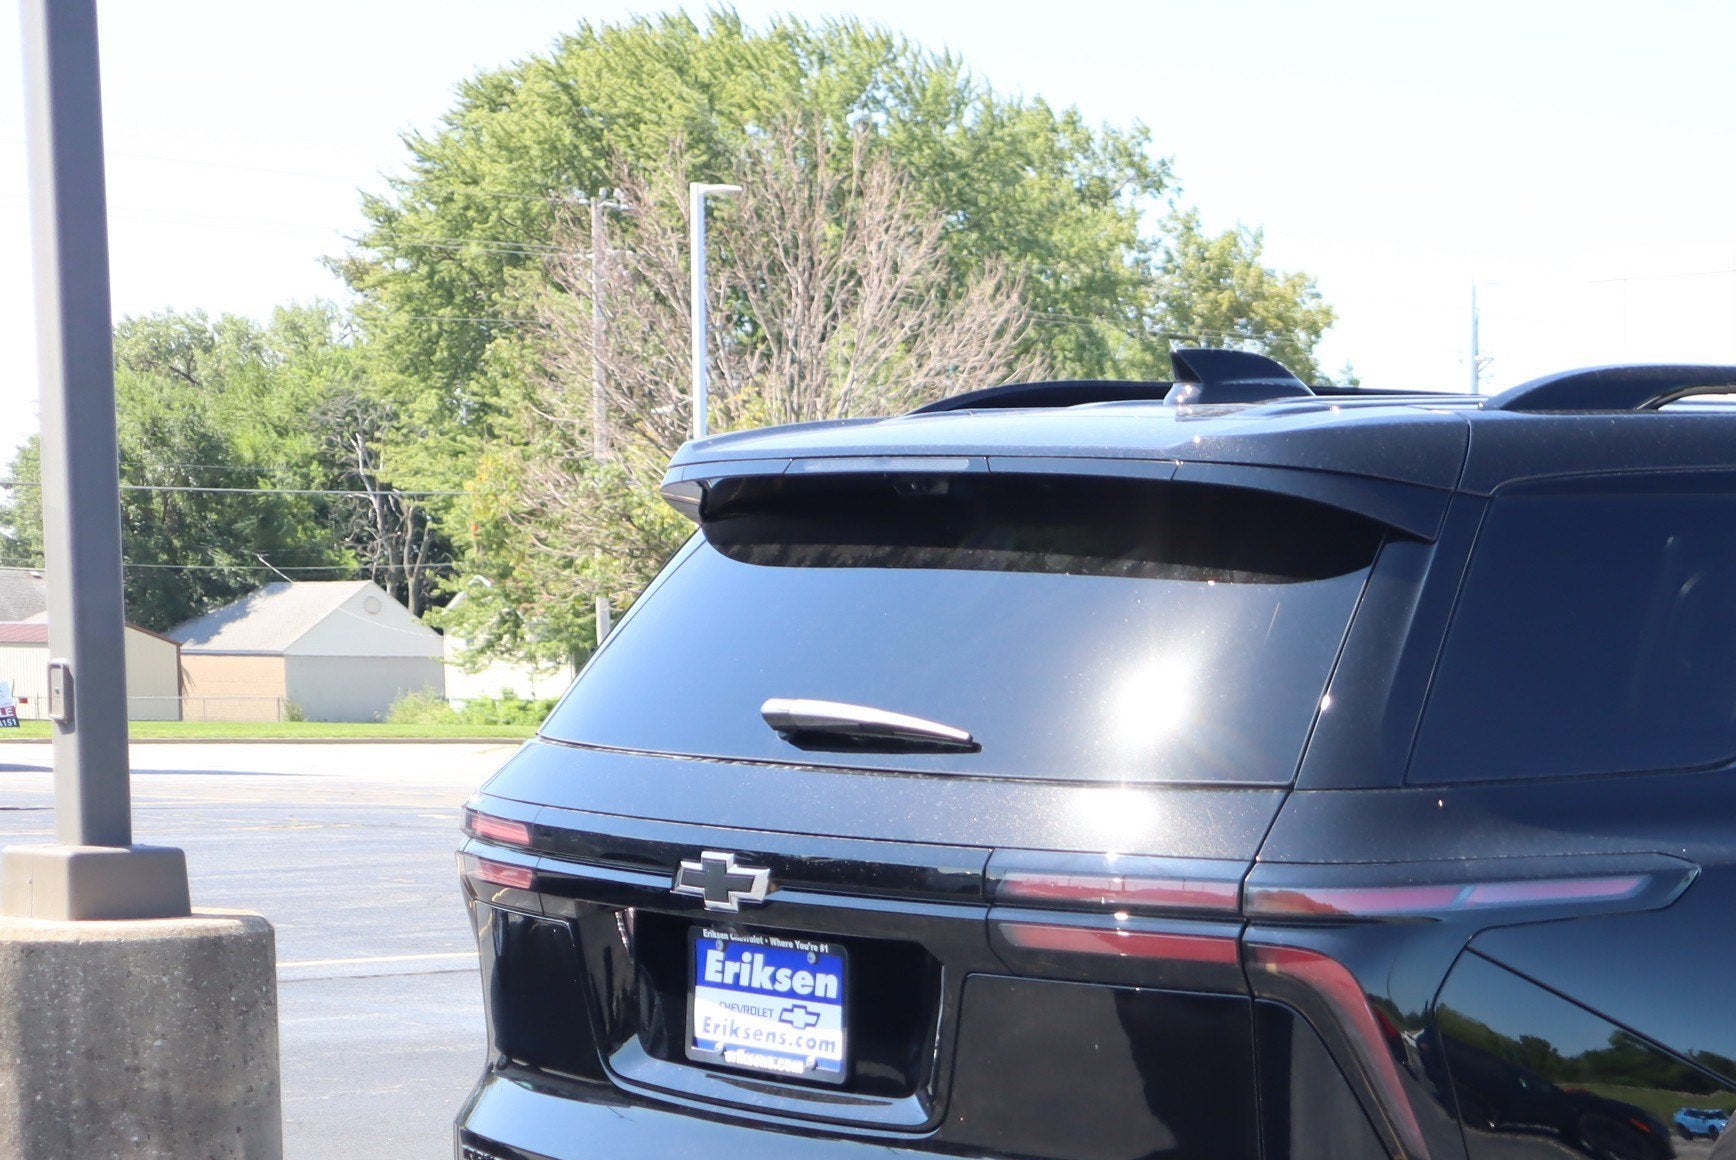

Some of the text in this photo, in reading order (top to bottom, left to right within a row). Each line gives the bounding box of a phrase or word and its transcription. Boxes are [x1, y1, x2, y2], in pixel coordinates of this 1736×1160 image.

[769, 936, 794, 949] Where
[704, 949, 838, 999] Eriksen
[718, 1001, 774, 1019] CHEVROLET
[702, 1016, 836, 1053] Eriksens.com
